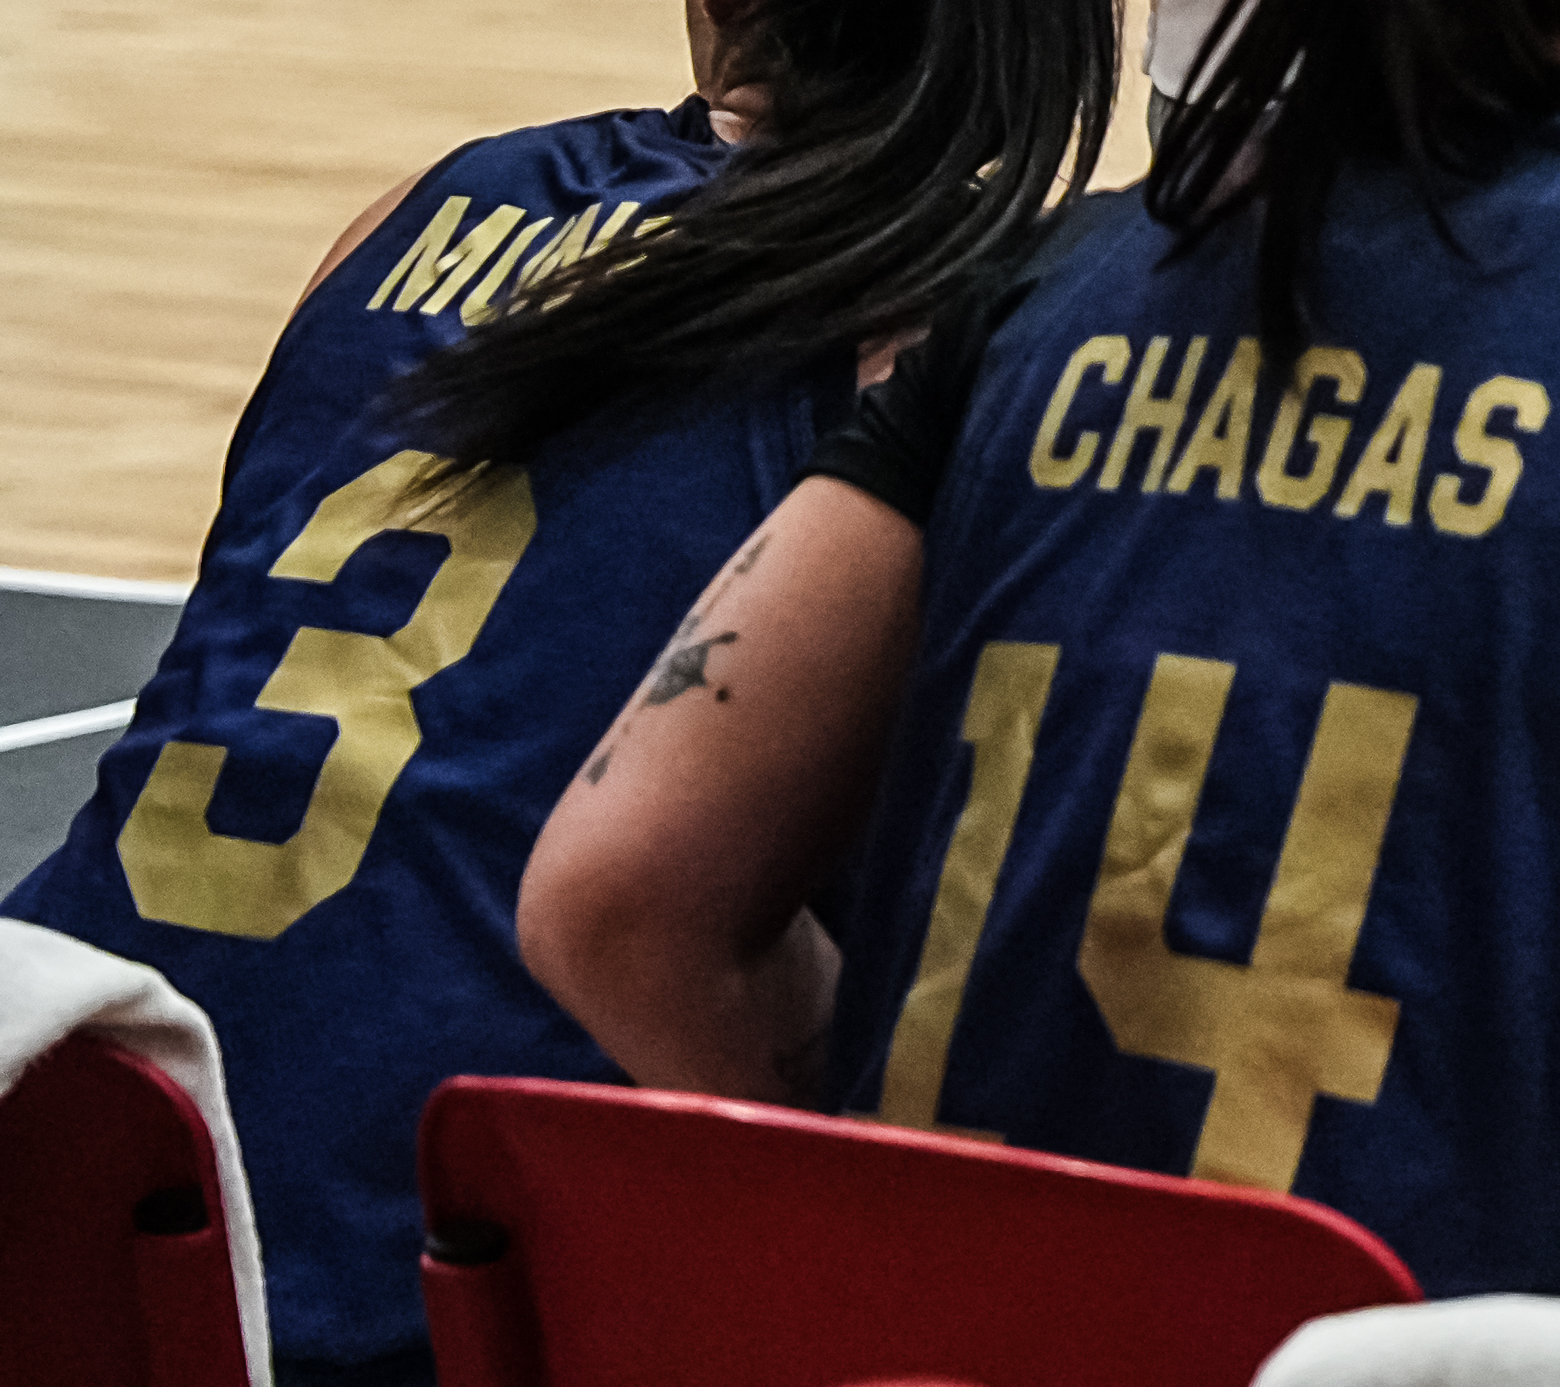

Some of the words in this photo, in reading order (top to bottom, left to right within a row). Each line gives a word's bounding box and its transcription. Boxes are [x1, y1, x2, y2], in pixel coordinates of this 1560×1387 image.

[1029, 334, 1551, 539] CHAGAS
[116, 448, 538, 940] 3
[858, 640, 1420, 1195] 14
